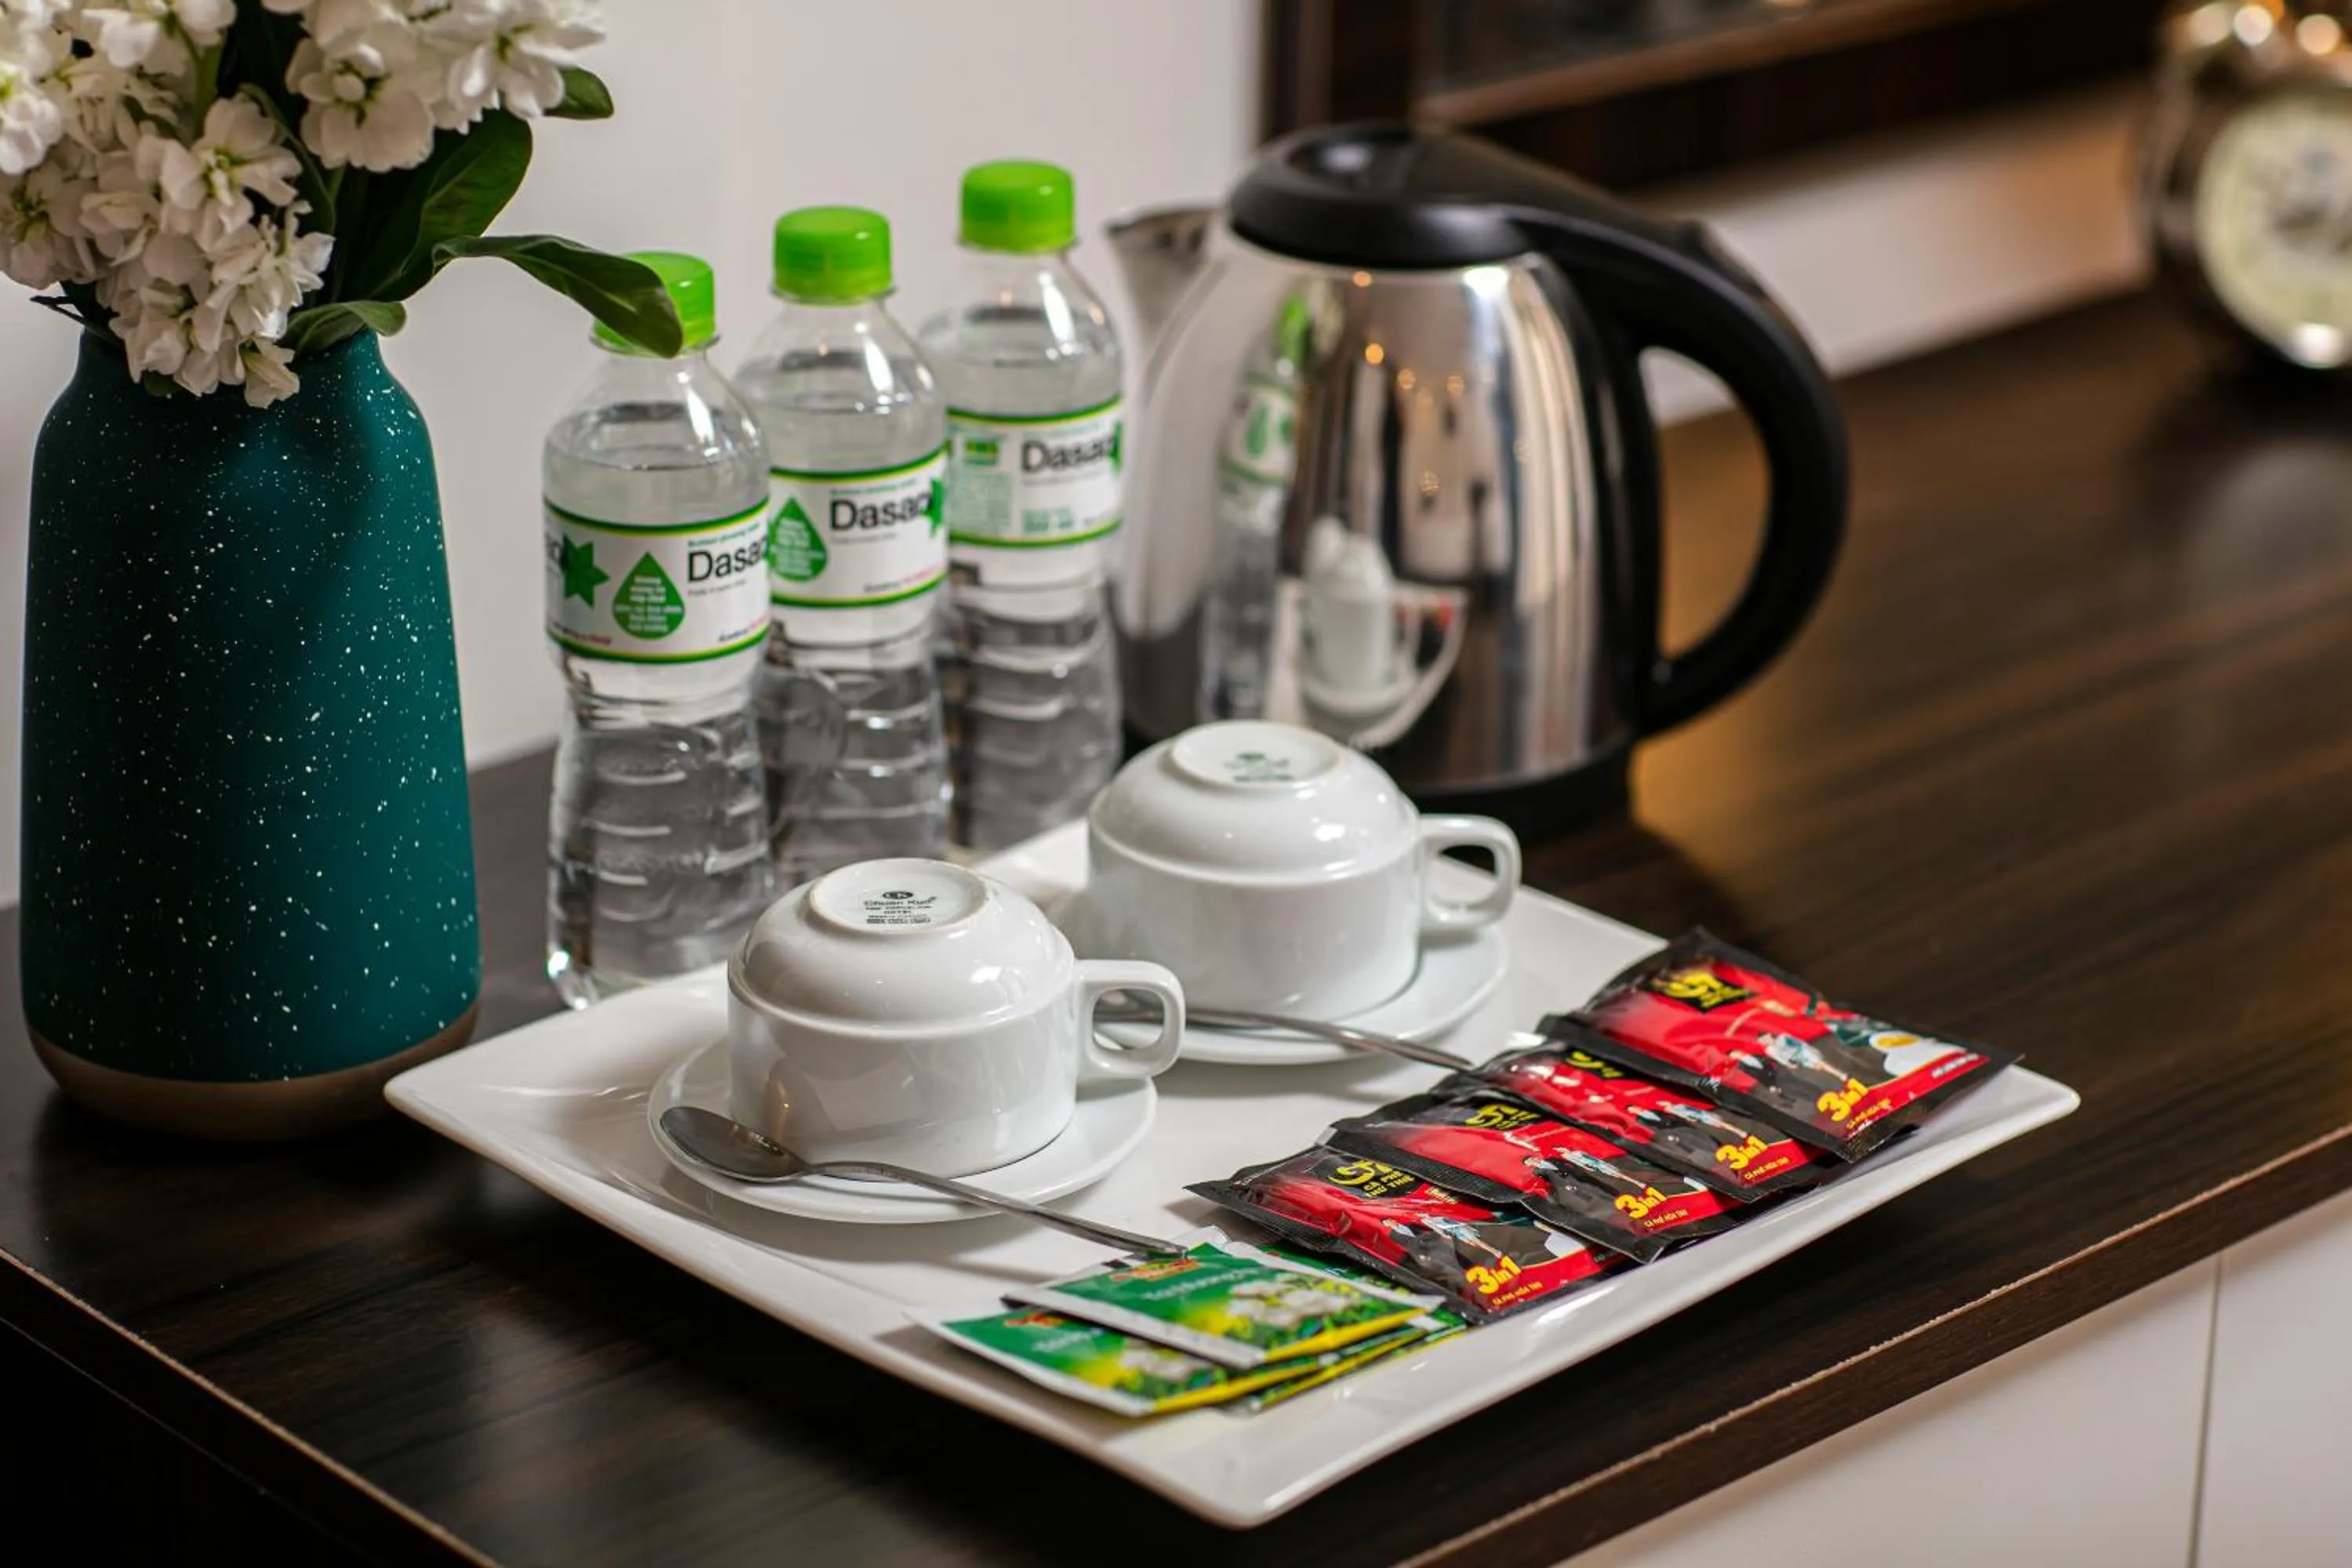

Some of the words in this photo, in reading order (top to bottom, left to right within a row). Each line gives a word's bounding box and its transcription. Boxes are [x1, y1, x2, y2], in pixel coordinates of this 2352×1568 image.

[1817, 1078, 1869, 1123] 3in1
[1715, 1135, 1768, 1171] 3in1
[1614, 1185, 1668, 1219] 3in1
[1465, 1255, 1522, 1295] 3in1
